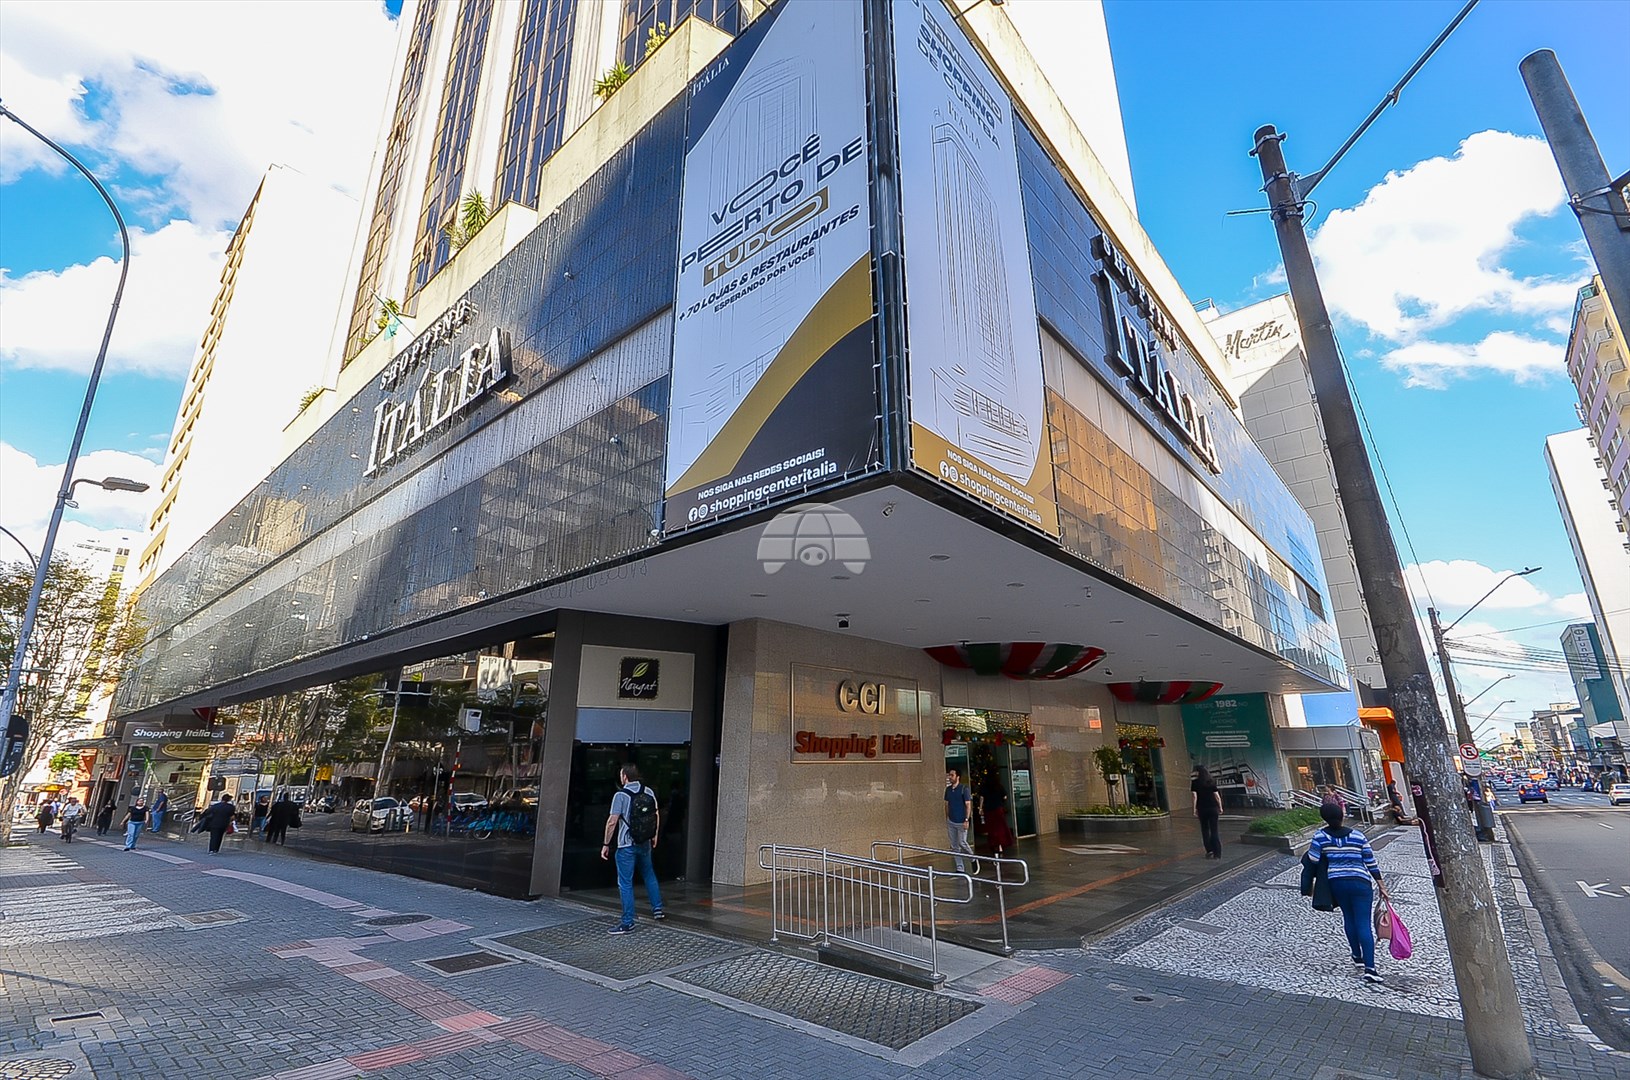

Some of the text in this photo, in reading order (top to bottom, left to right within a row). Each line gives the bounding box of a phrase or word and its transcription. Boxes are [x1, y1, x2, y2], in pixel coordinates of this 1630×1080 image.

[918, 37, 939, 72] DE
[920, 24, 994, 129] SHOPPING
[681, 136, 862, 274] PERTO DE
[711, 133, 820, 225] VOCÊ
[701, 279, 737, 309] LOJAS
[739, 272, 748, 285] &
[751, 205, 860, 276] RESTAURANTES
[707, 194, 824, 279] TUDO
[714, 247, 815, 312] ESPERANDO POR VOCÊ
[1101, 232, 1181, 351] SHOPPING
[380, 298, 471, 390] SHOPPING
[363, 327, 507, 477] ITÁLIA
[698, 448, 825, 500] NOS SIGA NAS REDES SOCIAIS!
[710, 461, 837, 513] shoppingcenteritalia
[960, 473, 1041, 524] shoppingcenteritalia
[838, 679, 886, 715] CCI
[1215, 700, 1237, 708] 1982
[133, 729, 182, 738] Shopping
[794, 731, 878, 758] Shopping
